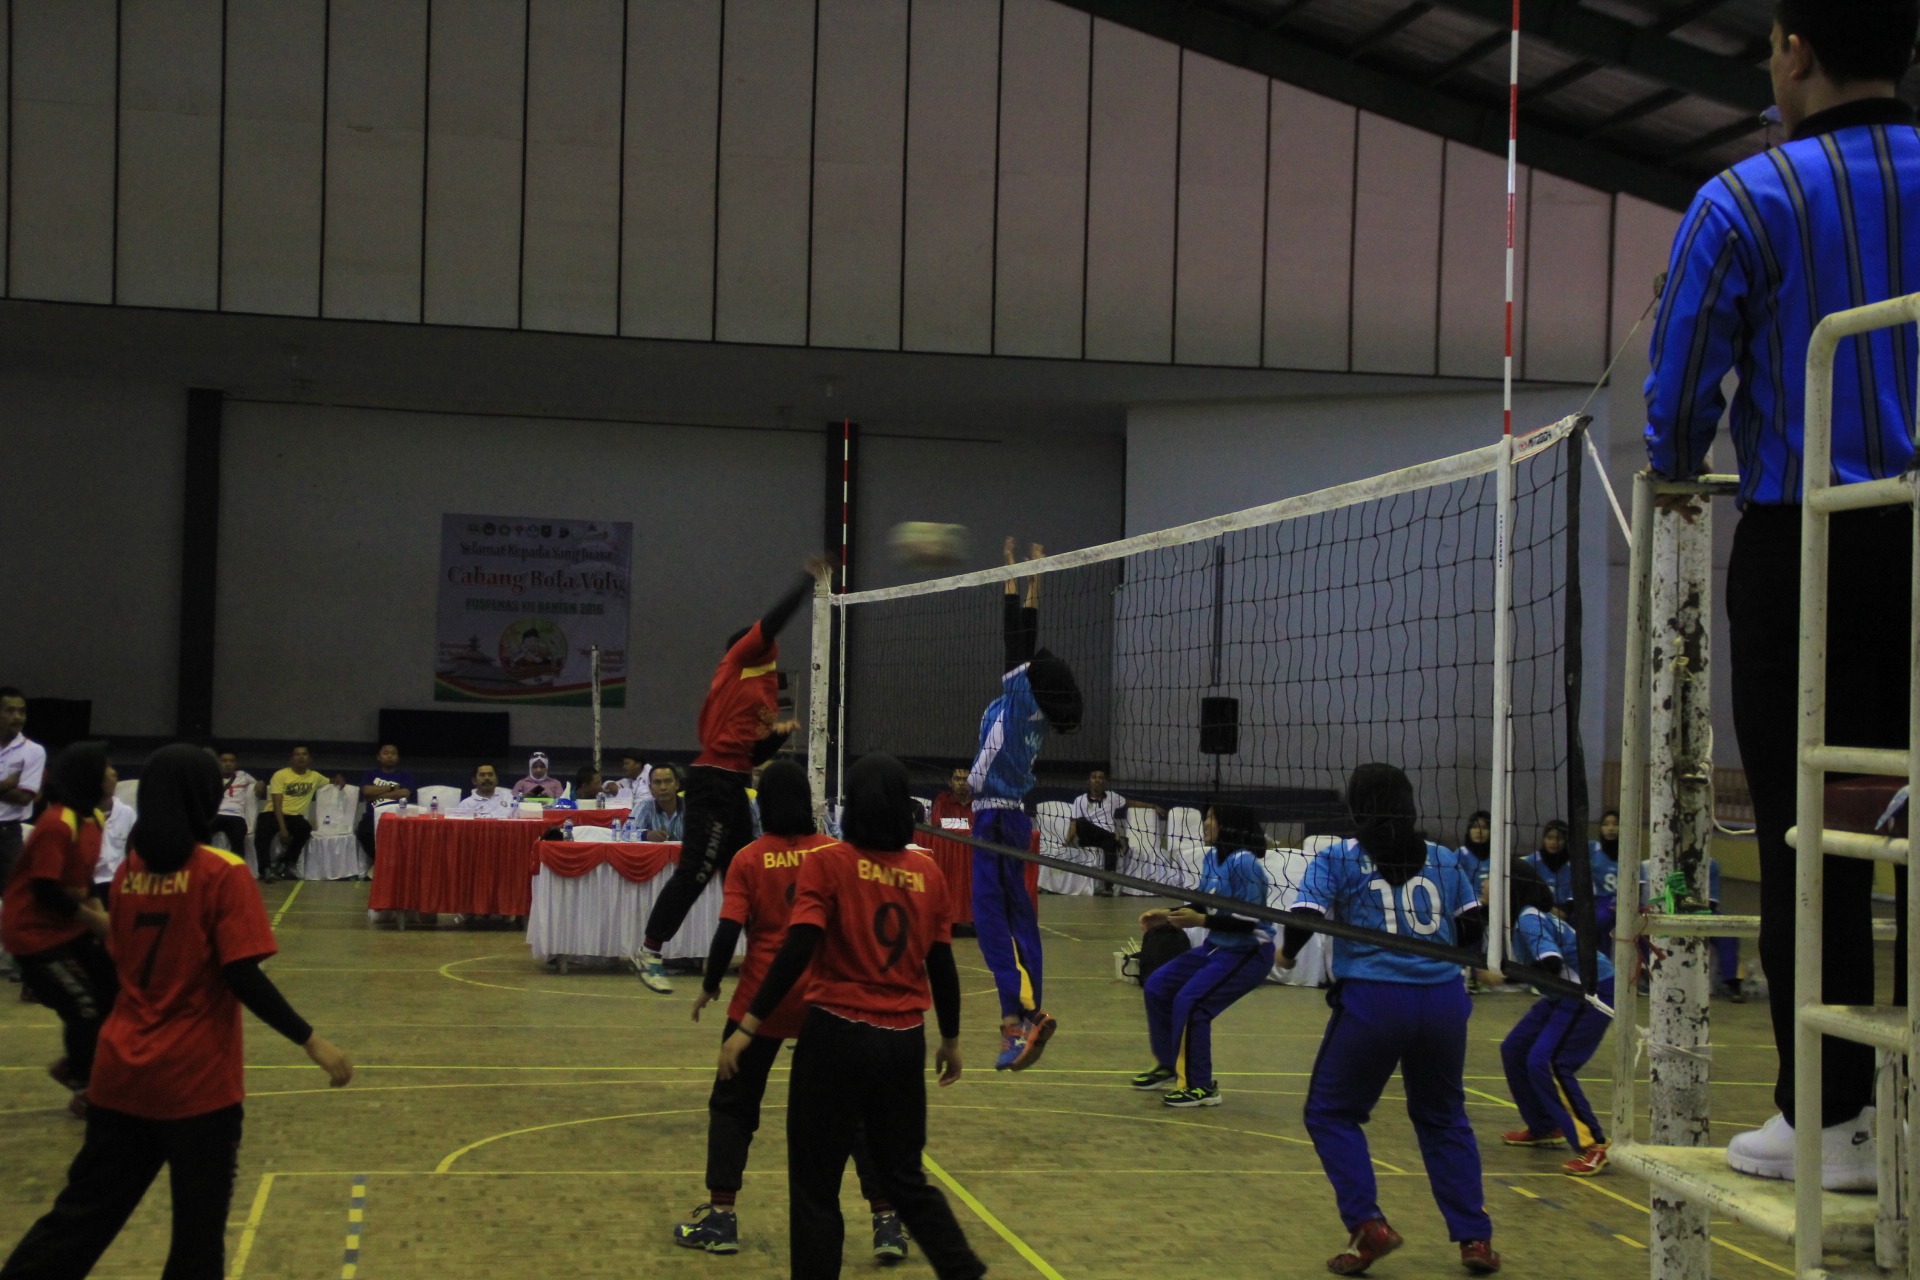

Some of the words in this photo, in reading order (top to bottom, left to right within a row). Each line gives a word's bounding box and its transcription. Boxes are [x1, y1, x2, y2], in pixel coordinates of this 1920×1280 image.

[507, 544, 550, 561] Kepada
[448, 565, 524, 595] Cabang
[530, 570, 574, 589] Bola
[538, 601, 577, 614] BANTEN
[580, 602, 605, 615] 2016
[706, 820, 723, 859] NIKE
[763, 850, 807, 869] BANT
[857, 859, 926, 893] BANTEN
[1368, 876, 1441, 936] 10
[133, 911, 171, 989] 7
[873, 902, 909, 974] 9
